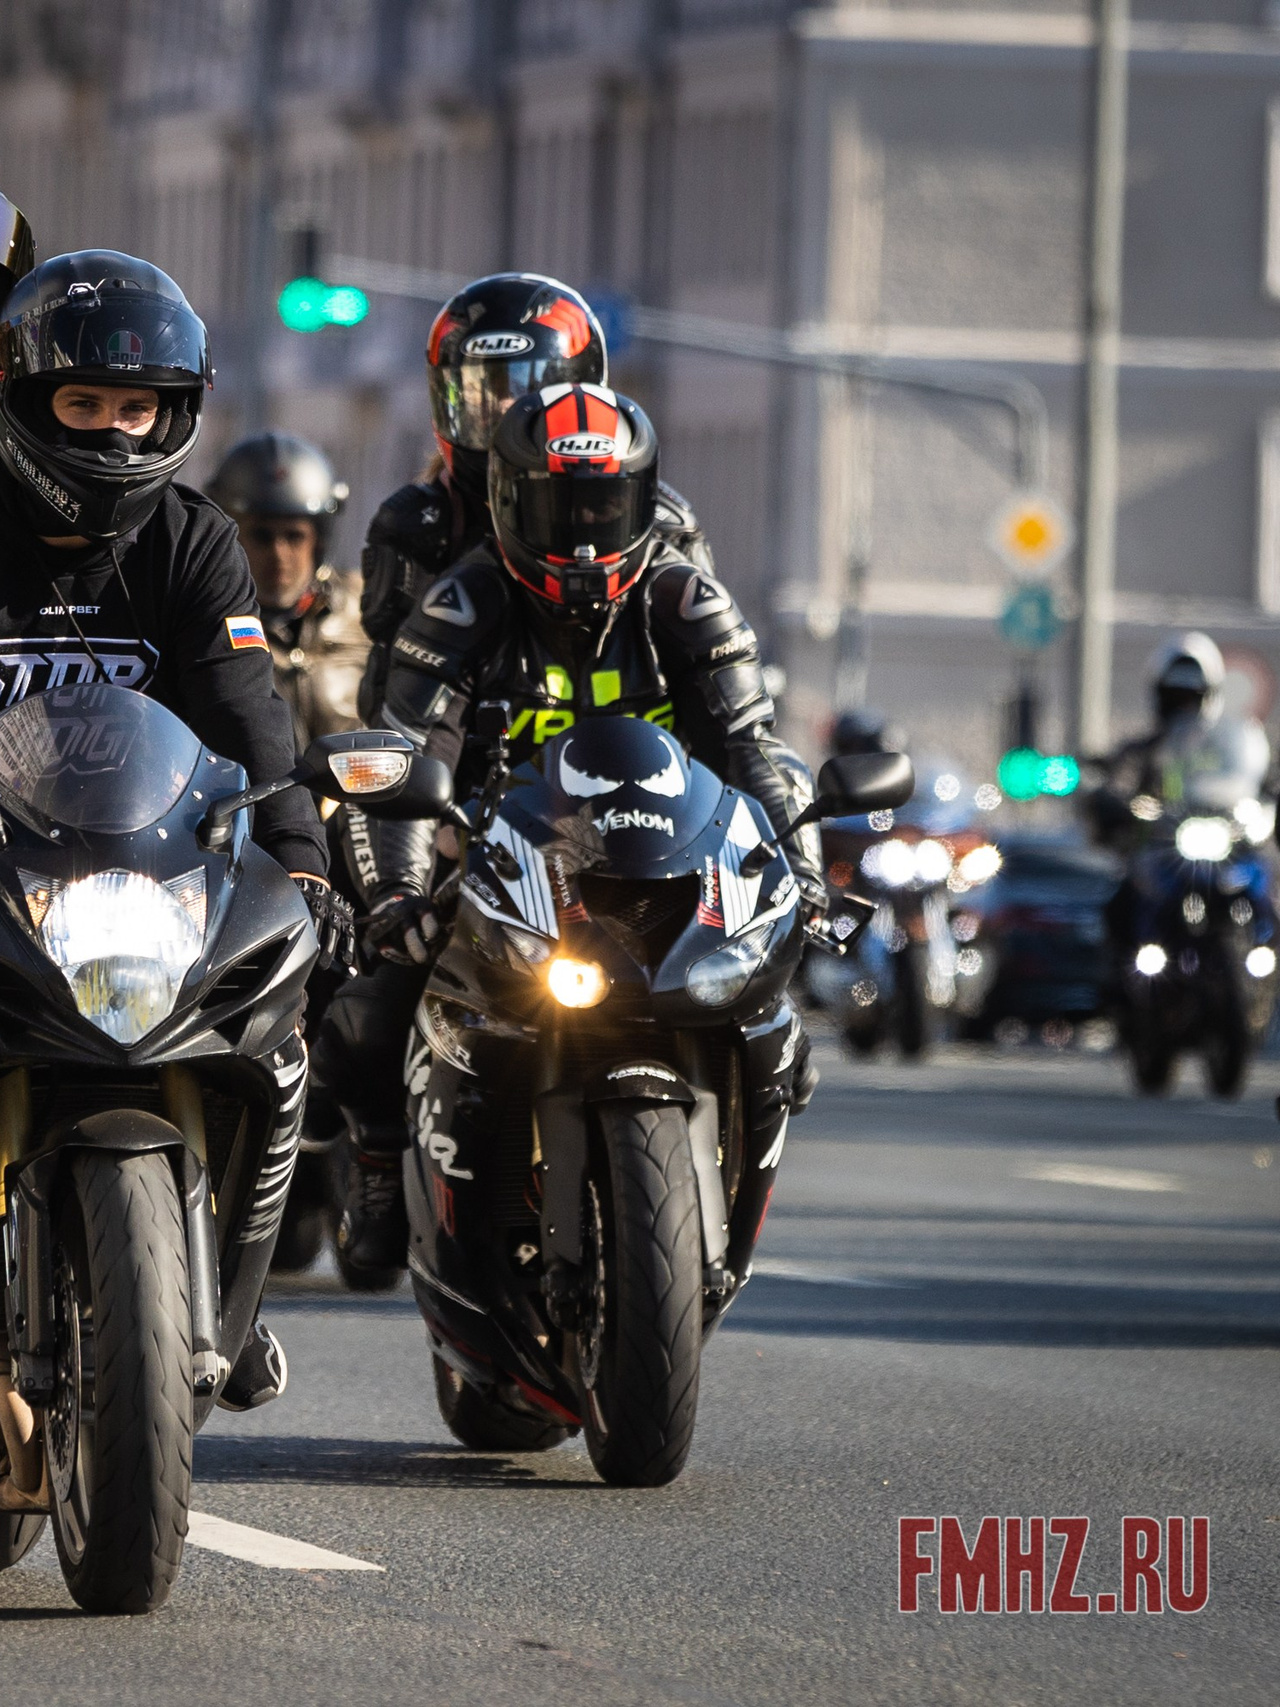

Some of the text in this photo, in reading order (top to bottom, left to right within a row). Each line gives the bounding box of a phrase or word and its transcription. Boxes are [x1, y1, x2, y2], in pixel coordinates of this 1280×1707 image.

[470, 338, 522, 352] HJC
[556, 440, 610, 452] HJC
[591, 808, 675, 838] VENOM
